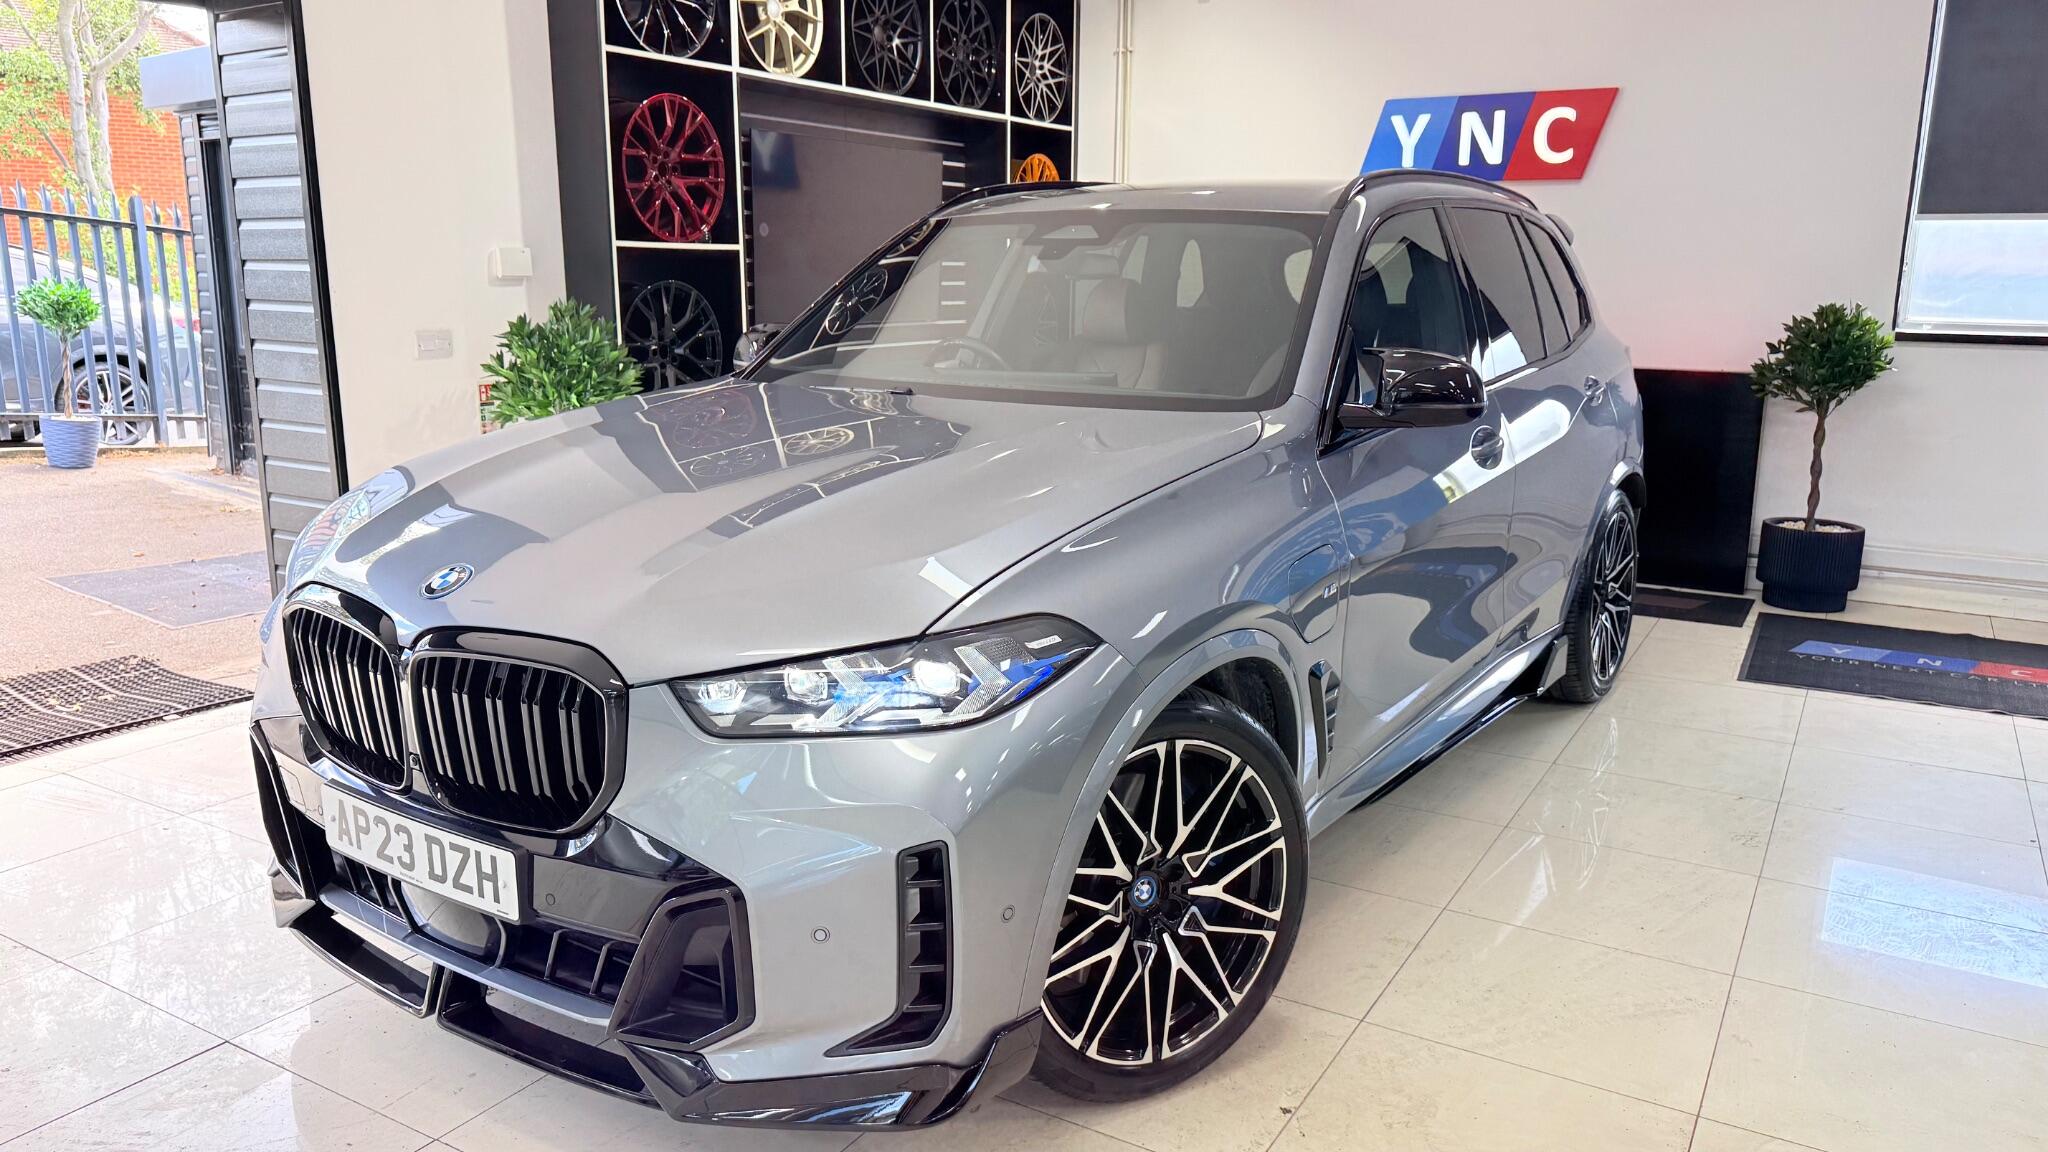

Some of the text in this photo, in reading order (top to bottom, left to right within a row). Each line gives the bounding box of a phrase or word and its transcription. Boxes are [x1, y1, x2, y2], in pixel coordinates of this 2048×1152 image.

[1390, 106, 1577, 168] YNC
[1796, 653, 1859, 665] YOUR
[1873, 663, 1936, 675] NEXT
[1950, 672, 1999, 682] CAR
[338, 799, 500, 904] AP23 DZH
